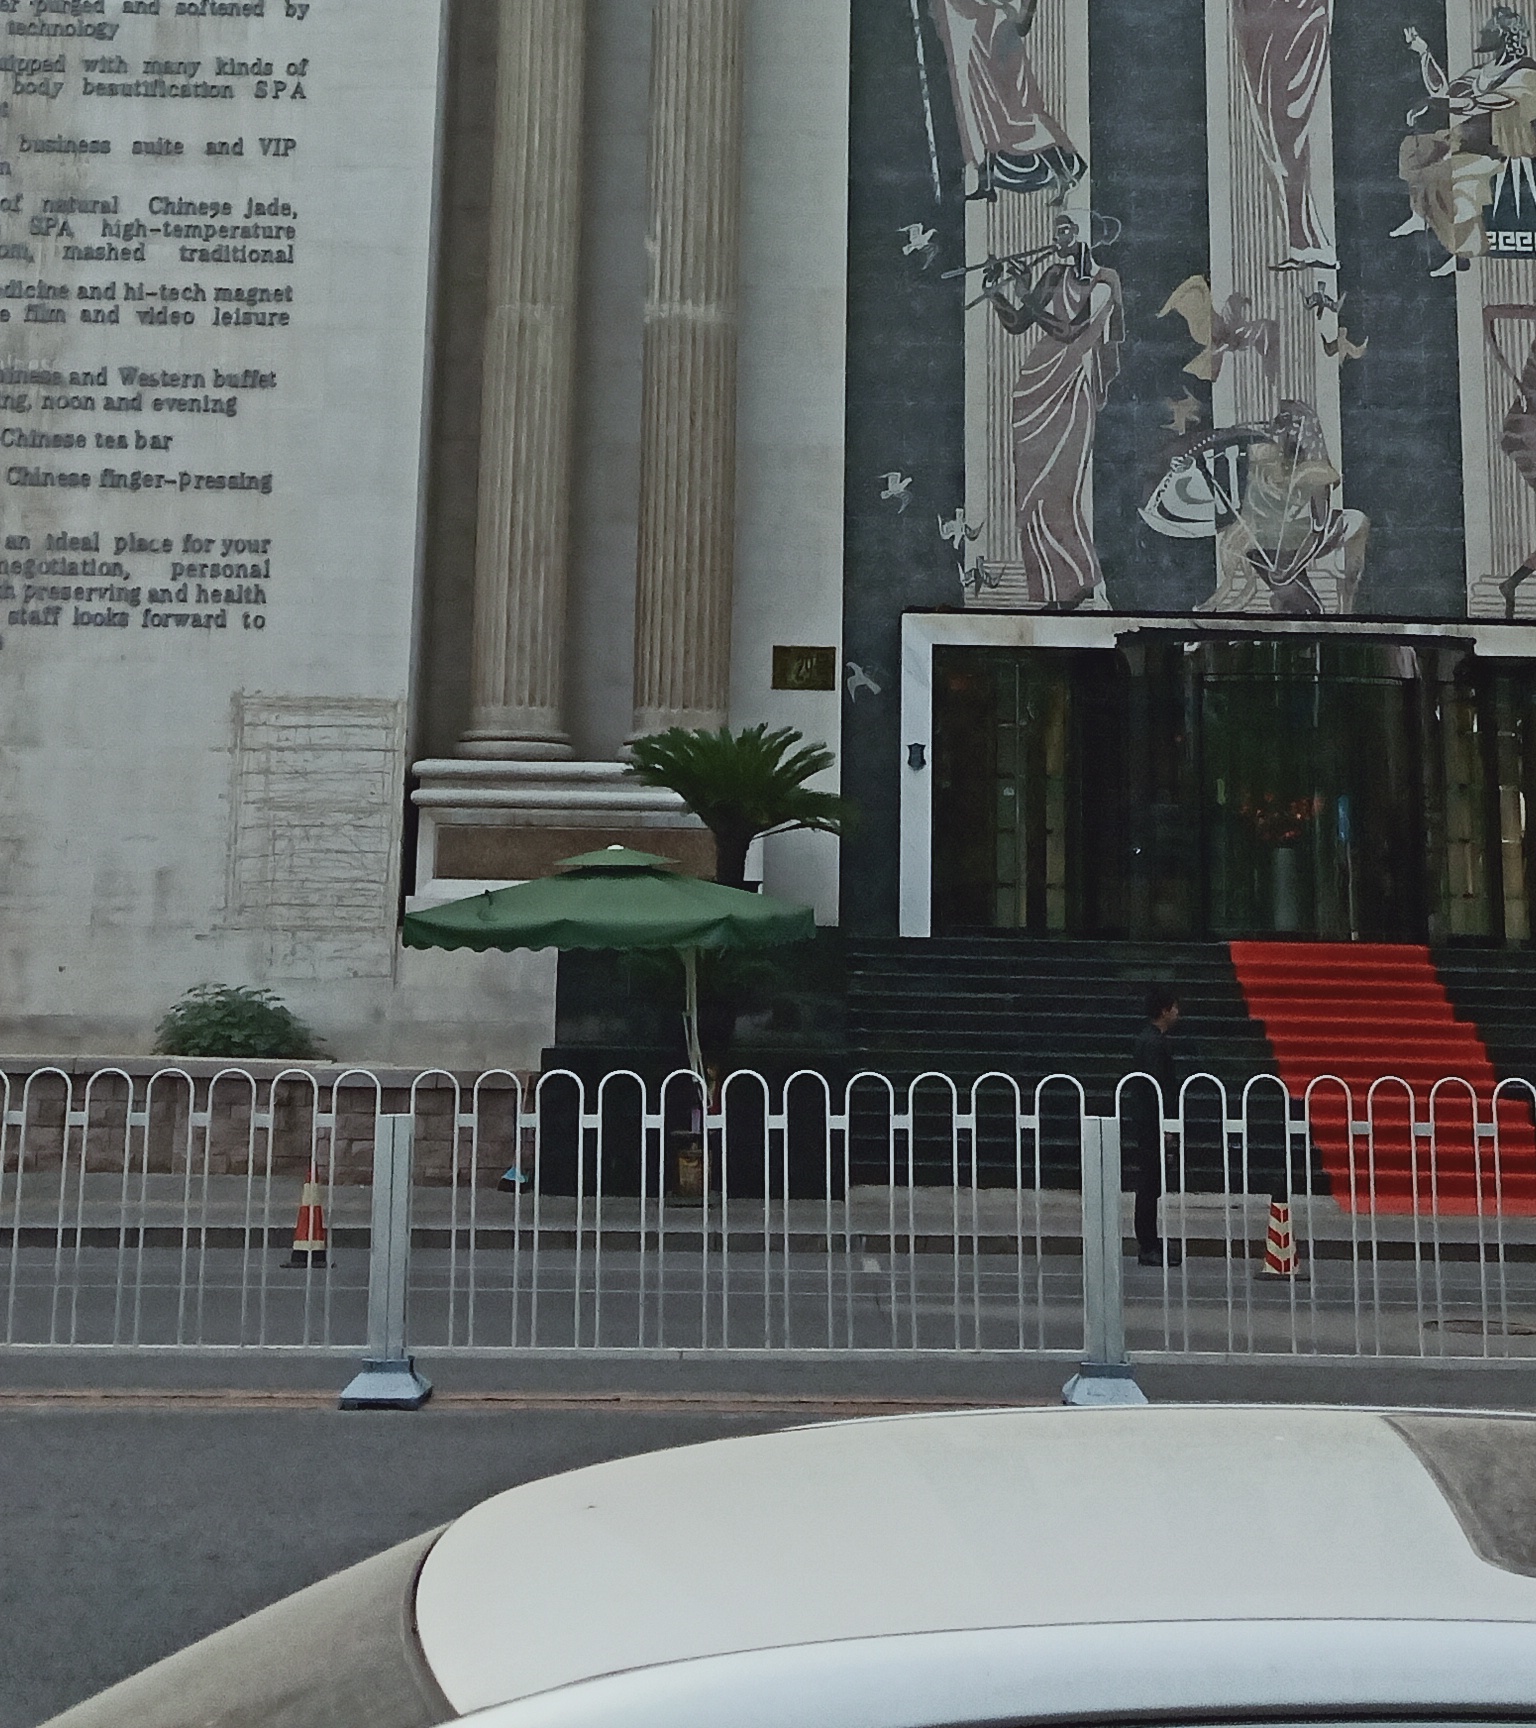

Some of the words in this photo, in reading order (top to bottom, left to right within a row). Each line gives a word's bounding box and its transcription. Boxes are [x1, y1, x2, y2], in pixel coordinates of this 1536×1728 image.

[285, 0, 309, 20] by
[6, 18, 119, 41] technology
[82, 55, 128, 73] with
[143, 60, 201, 78] many
[216, 57, 273, 76] kinds
[287, 58, 309, 76] of
[13, 77, 64, 99] body
[83, 77, 234, 98] beautification
[19, 134, 111, 153] business
[132, 137, 184, 155] suite
[206, 137, 244, 156] and
[259, 138, 297, 156] VIP
[0, 193, 23, 212] of
[42, 196, 118, 214] natural
[148, 196, 232, 218] Chinese
[244, 197, 298, 219] jade,
[29, 216, 74, 238] SPA
[101, 218, 296, 242] high-temperature
[179, 244, 294, 263] traditional
[77, 281, 116, 300] and
[124, 282, 207, 301] hi-tech
[214, 285, 294, 306] magnet
[80, 304, 119, 324] and
[136, 306, 195, 325] video
[212, 307, 290, 326] leisure
[69, 366, 107, 386] and
[118, 366, 206, 388] Western
[213, 368, 278, 388] buffet
[41, 394, 95, 410] noon
[103, 391, 143, 411] and
[152, 395, 237, 417] evening
[0, 428, 87, 448] Chinese
[95, 433, 128, 449] tea
[134, 429, 173, 451] bar
[7, 466, 91, 487] Chinese
[99, 468, 273, 494] finger-pressing
[5, 534, 30, 550] an
[46, 531, 99, 553] ideal
[114, 532, 173, 555] place
[182, 534, 215, 553] for
[221, 538, 272, 557] your
[170, 558, 270, 581] personal
[24, 583, 141, 606] preserving
[148, 582, 188, 603] and
[195, 584, 267, 604] health
[8, 605, 62, 625] staff
[73, 606, 129, 627] looks
[141, 608, 227, 628] forward
[243, 611, 266, 630] to
